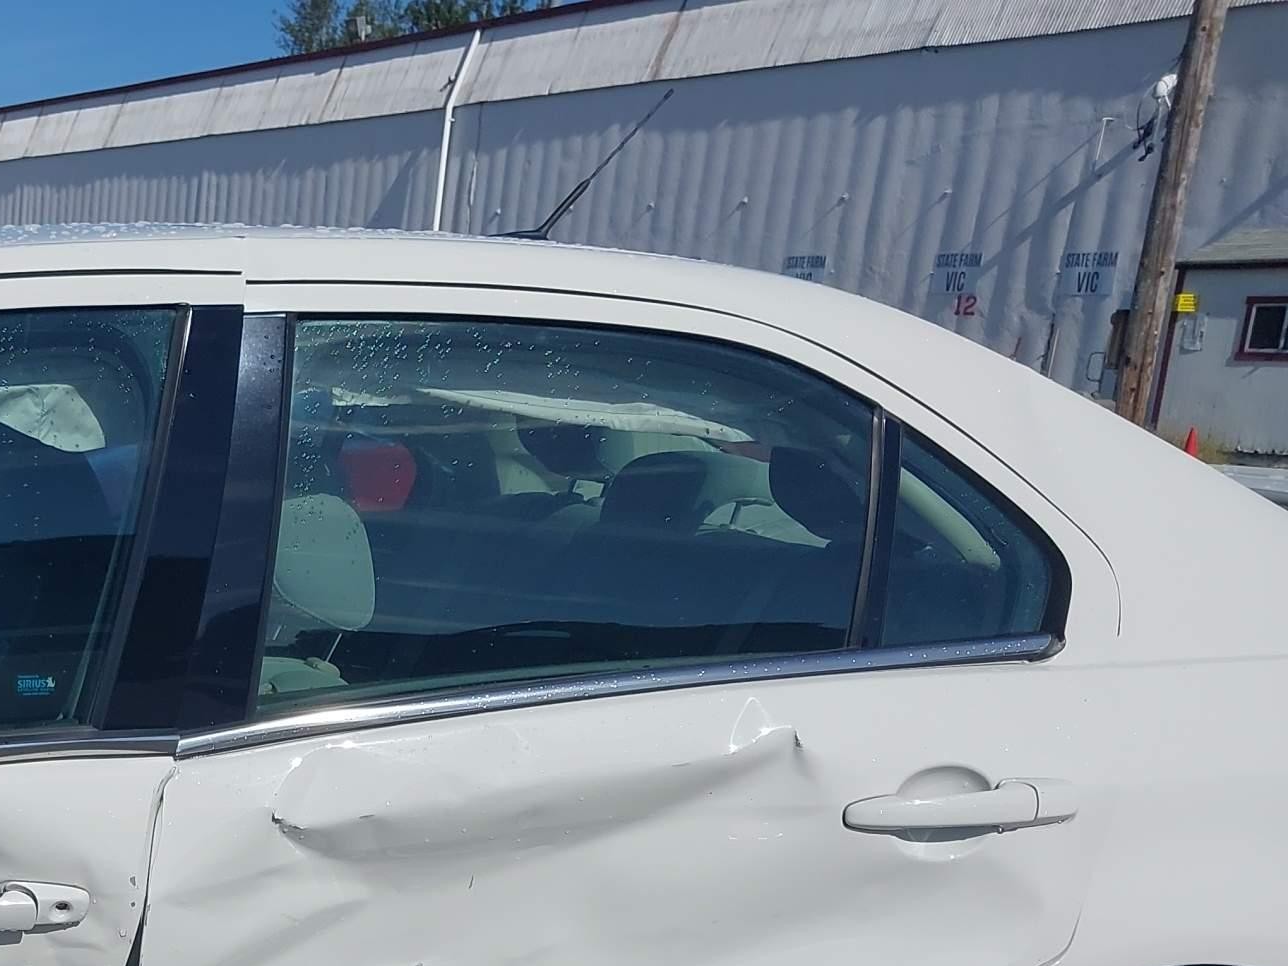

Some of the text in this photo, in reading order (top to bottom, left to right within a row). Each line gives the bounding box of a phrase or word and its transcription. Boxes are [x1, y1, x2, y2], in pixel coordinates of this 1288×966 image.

[787, 256, 826, 269] STATE FARM
[936, 252, 982, 268] STATE FARM
[1065, 251, 1119, 268] STATE FARM
[945, 271, 966, 292] VIC
[1077, 271, 1100, 293] VIC
[954, 294, 977, 316] 12
[17, 679, 46, 688] SIRIUS
